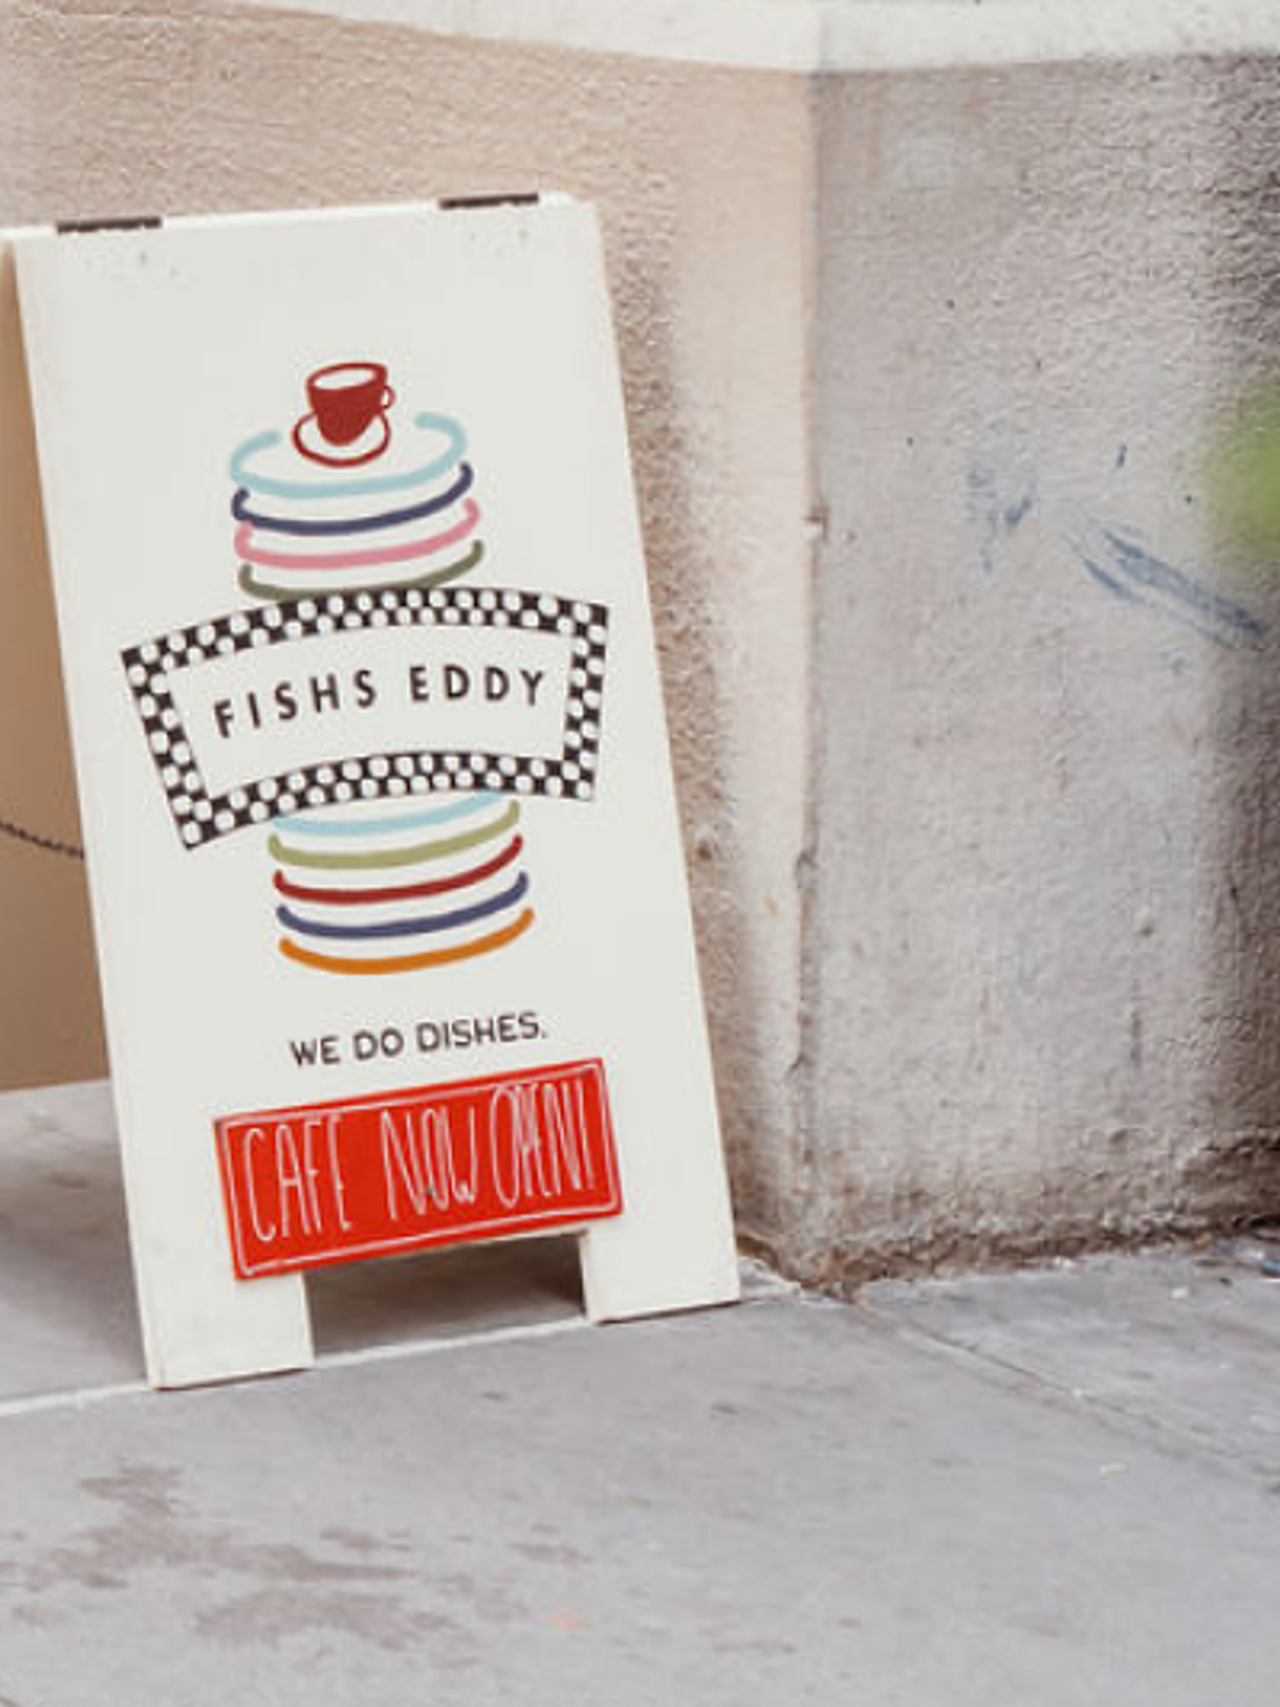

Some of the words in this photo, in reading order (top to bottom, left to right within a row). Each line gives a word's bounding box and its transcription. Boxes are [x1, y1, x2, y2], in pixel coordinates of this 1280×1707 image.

[213, 669, 378, 738] FISHS
[409, 663, 545, 706] EDDY
[290, 1034, 341, 1068] WE
[353, 1027, 405, 1062] DO
[416, 1011, 547, 1053] DISHES.
[244, 1110, 352, 1242] CAFE
[381, 1104, 478, 1219] NOW
